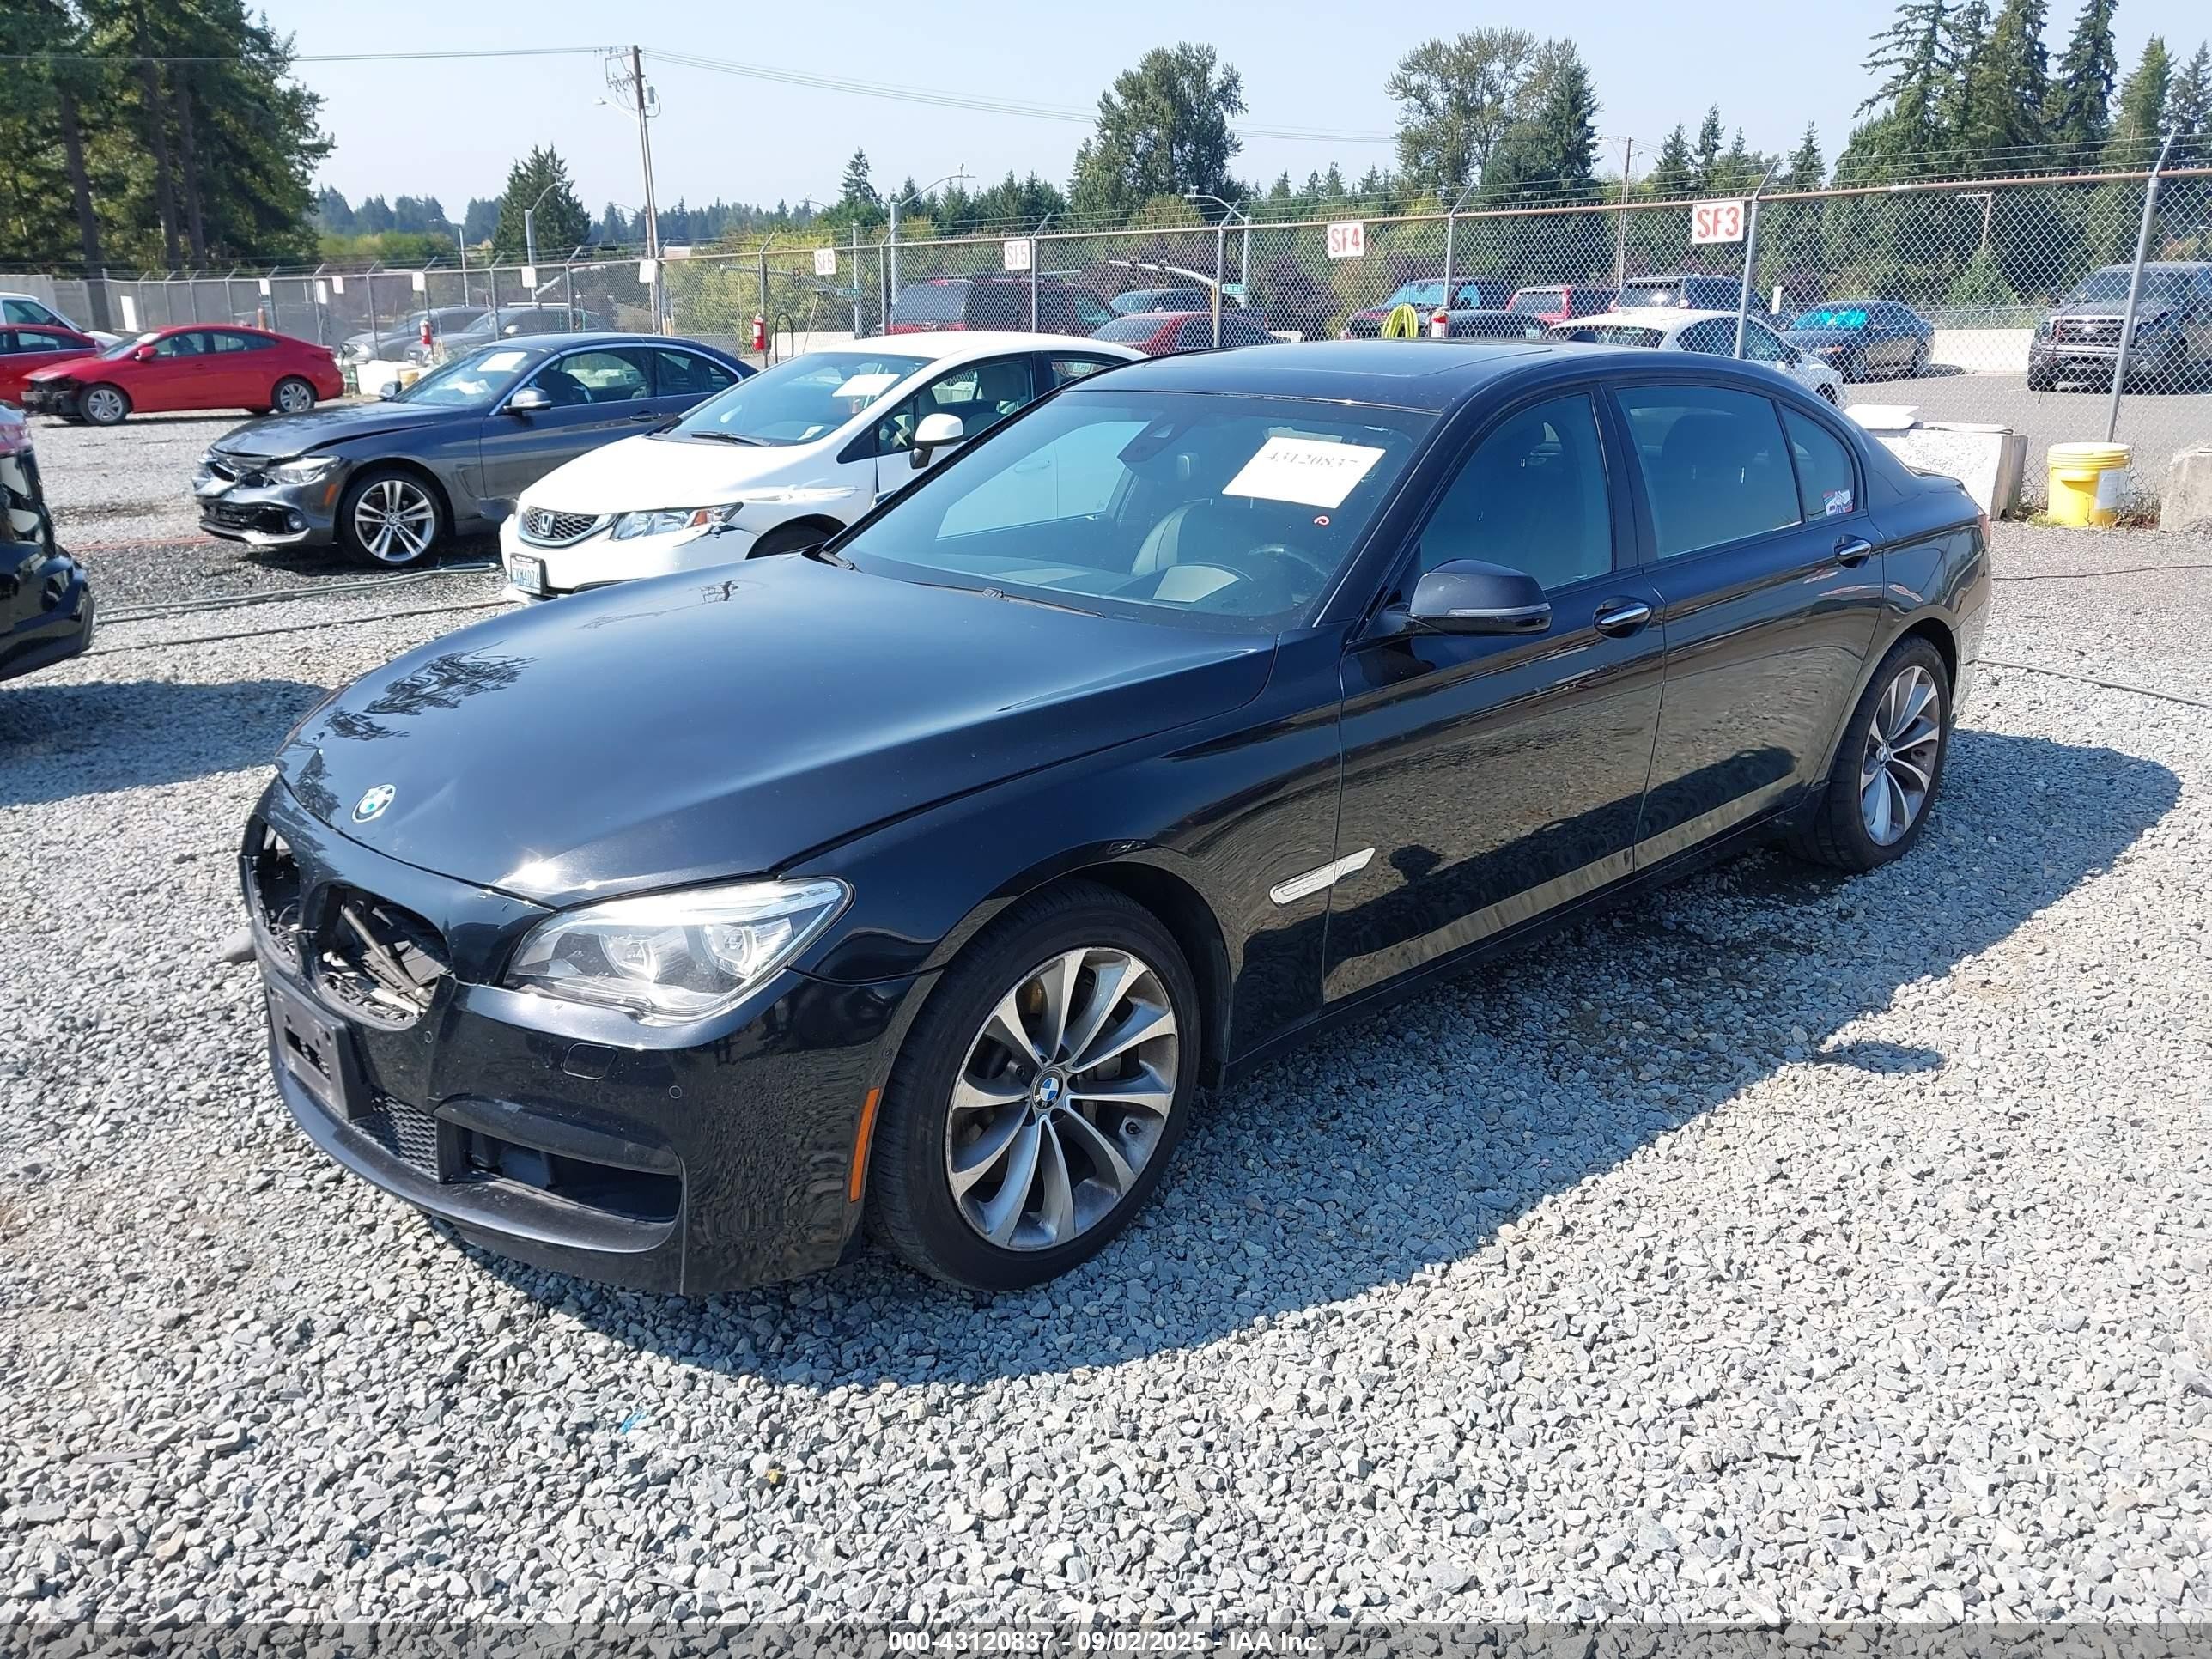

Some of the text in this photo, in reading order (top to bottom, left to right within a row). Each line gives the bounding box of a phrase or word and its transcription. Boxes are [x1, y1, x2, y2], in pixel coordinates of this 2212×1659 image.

[1698, 206, 1739, 238] SF3
[1331, 227, 1360, 252] SF4
[817, 252, 833, 271] SF6
[1007, 244, 1027, 265] SF5
